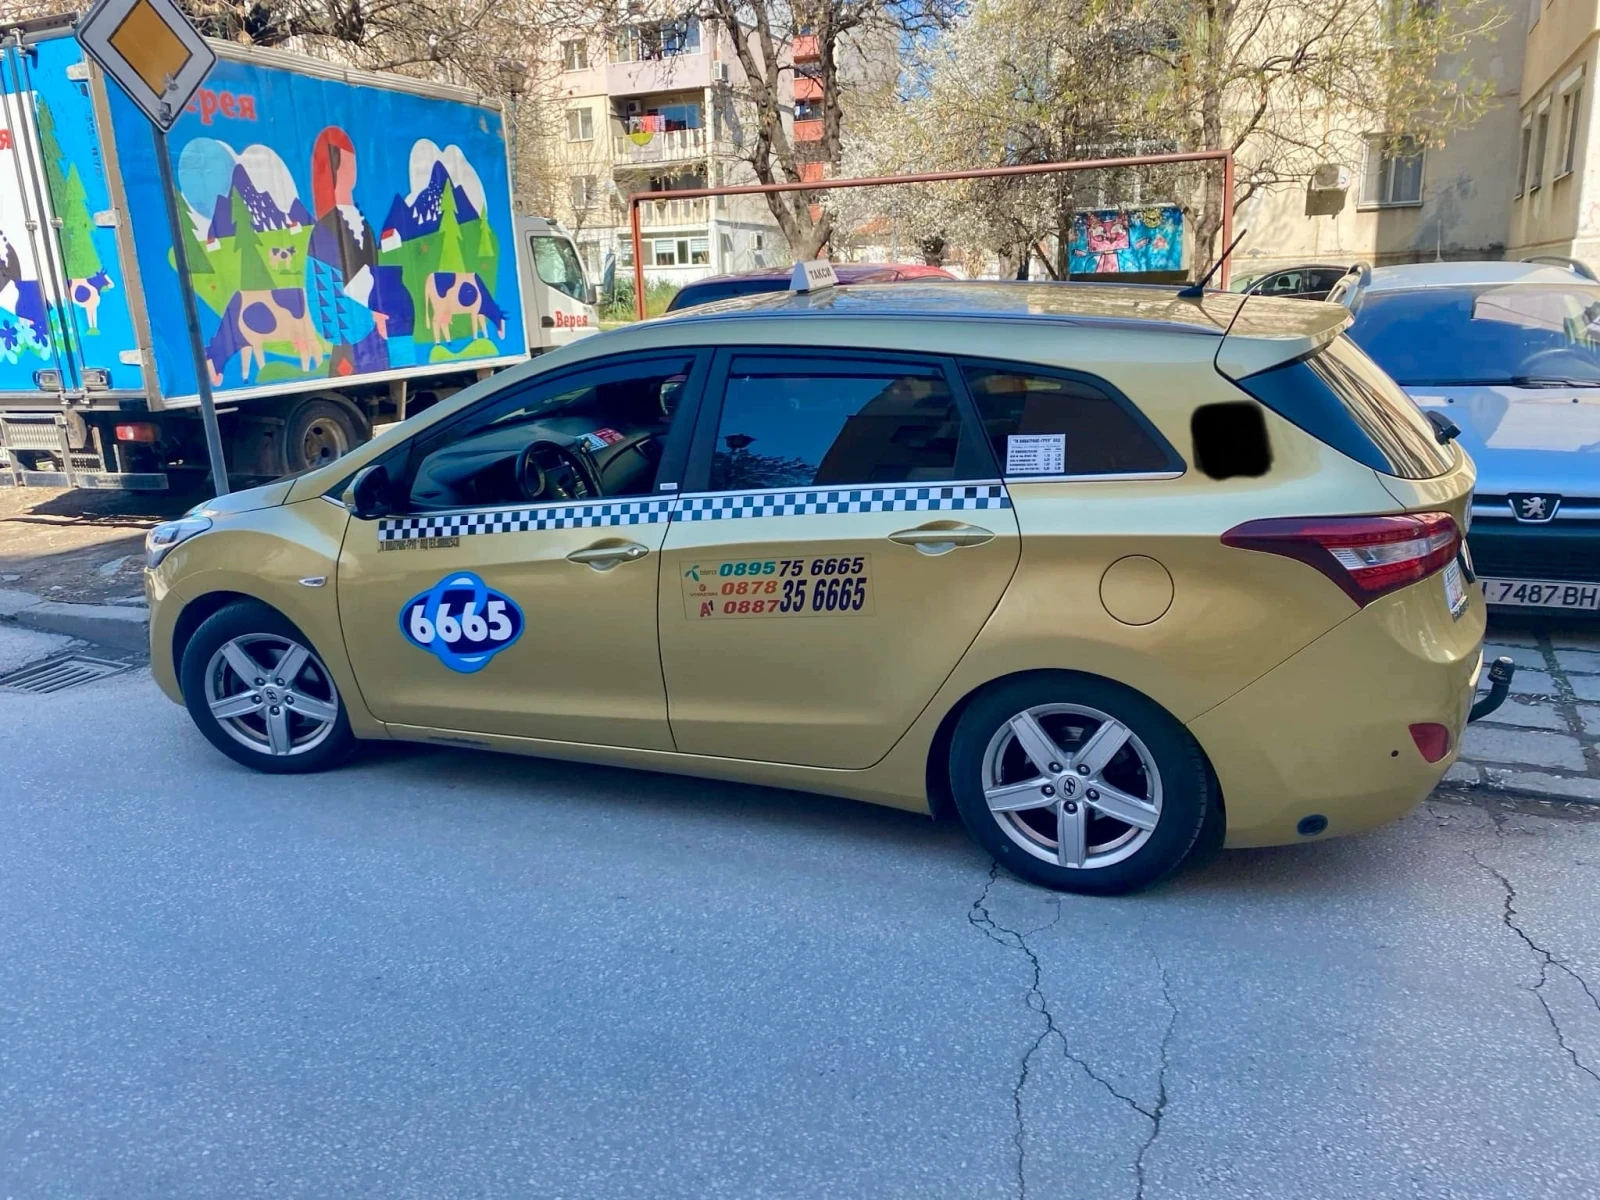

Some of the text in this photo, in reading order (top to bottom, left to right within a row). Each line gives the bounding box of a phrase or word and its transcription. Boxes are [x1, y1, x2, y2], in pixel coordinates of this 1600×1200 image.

[808, 266, 833, 281] ТАКСИ
[555, 310, 588, 332] Верея
[719, 557, 865, 577] 0895 75 6665
[721, 580, 778, 596] 0878
[780, 577, 867, 612] 35 6665
[1498, 582, 1560, 605] 7487
[700, 599, 714, 617] A1
[723, 599, 780, 615] 0887
[410, 600, 513, 644] 6665
